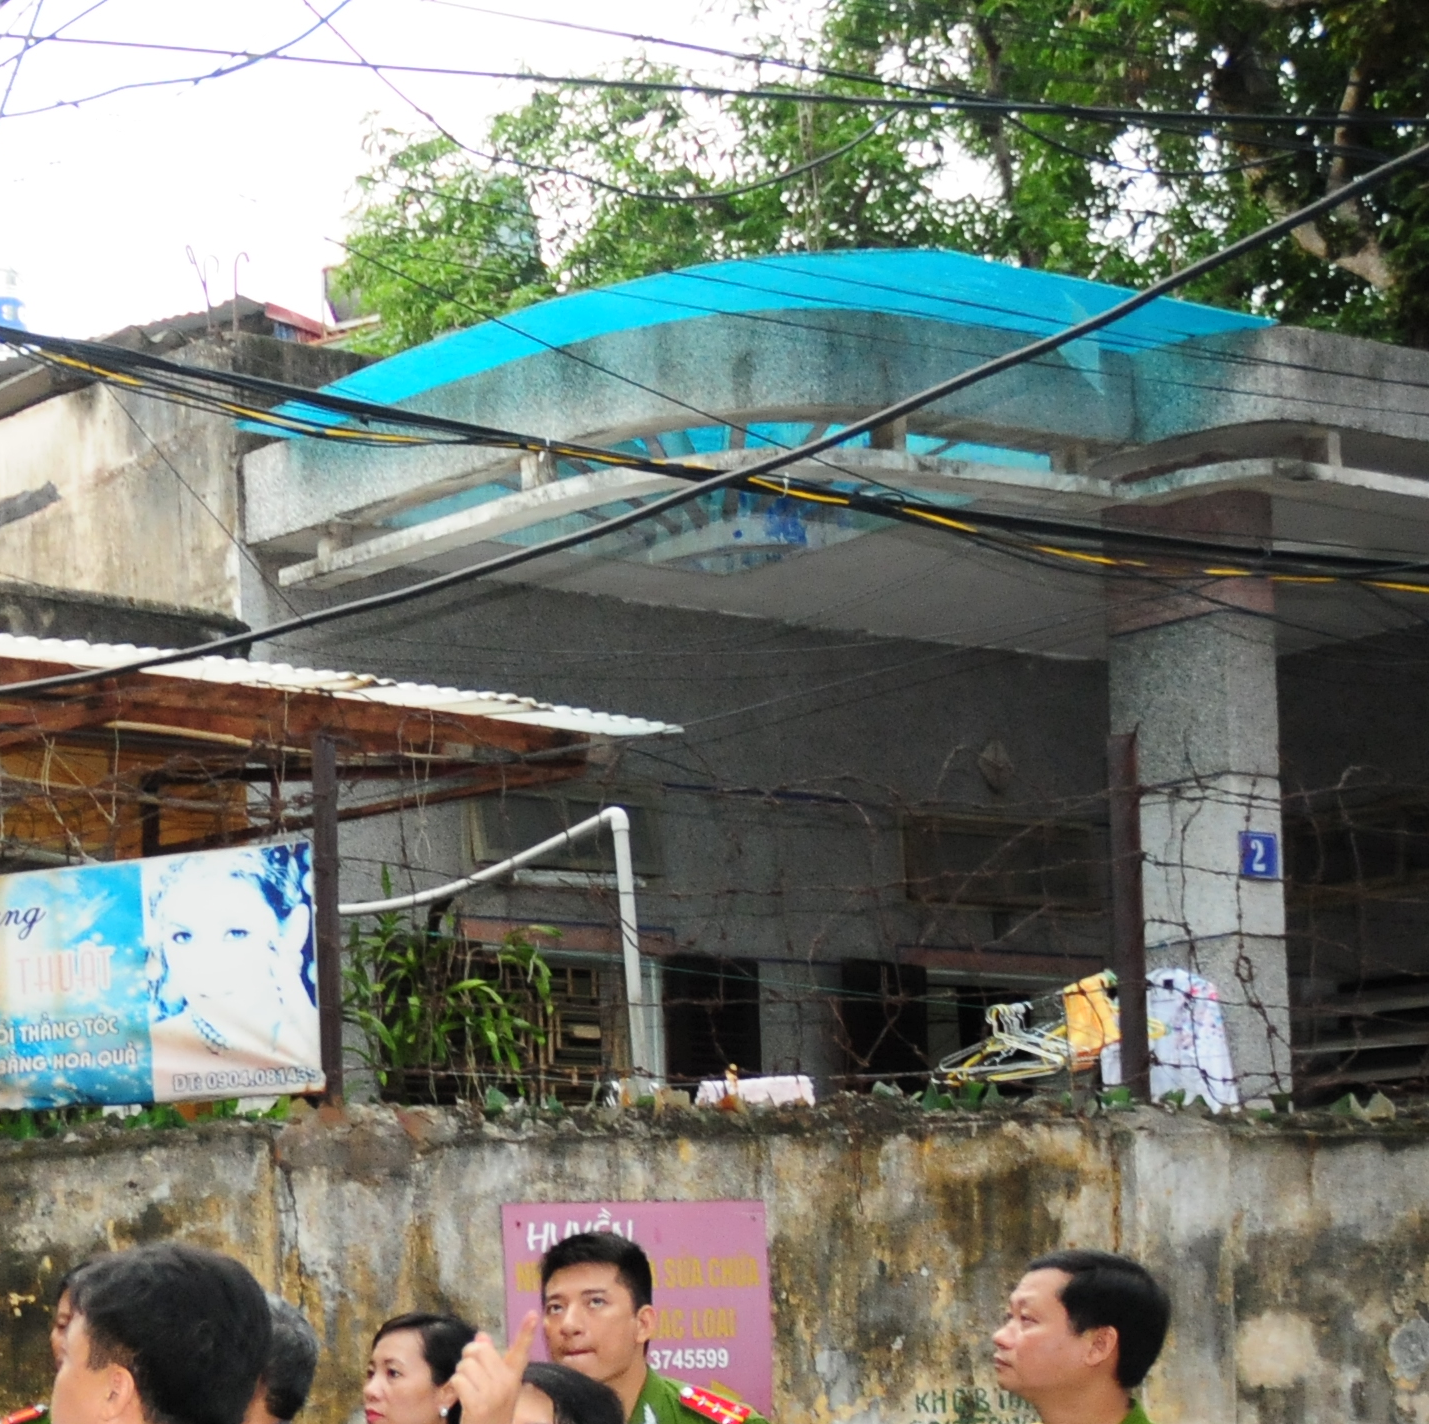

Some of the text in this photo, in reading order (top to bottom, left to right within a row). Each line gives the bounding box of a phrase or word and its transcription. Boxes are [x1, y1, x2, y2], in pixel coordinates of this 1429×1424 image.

[1250, 839, 1266, 872] 2
[84, 1013, 119, 1037] TÓC
[53, 1051, 92, 1070] HOA
[649, 1347, 729, 1370] 3745599
